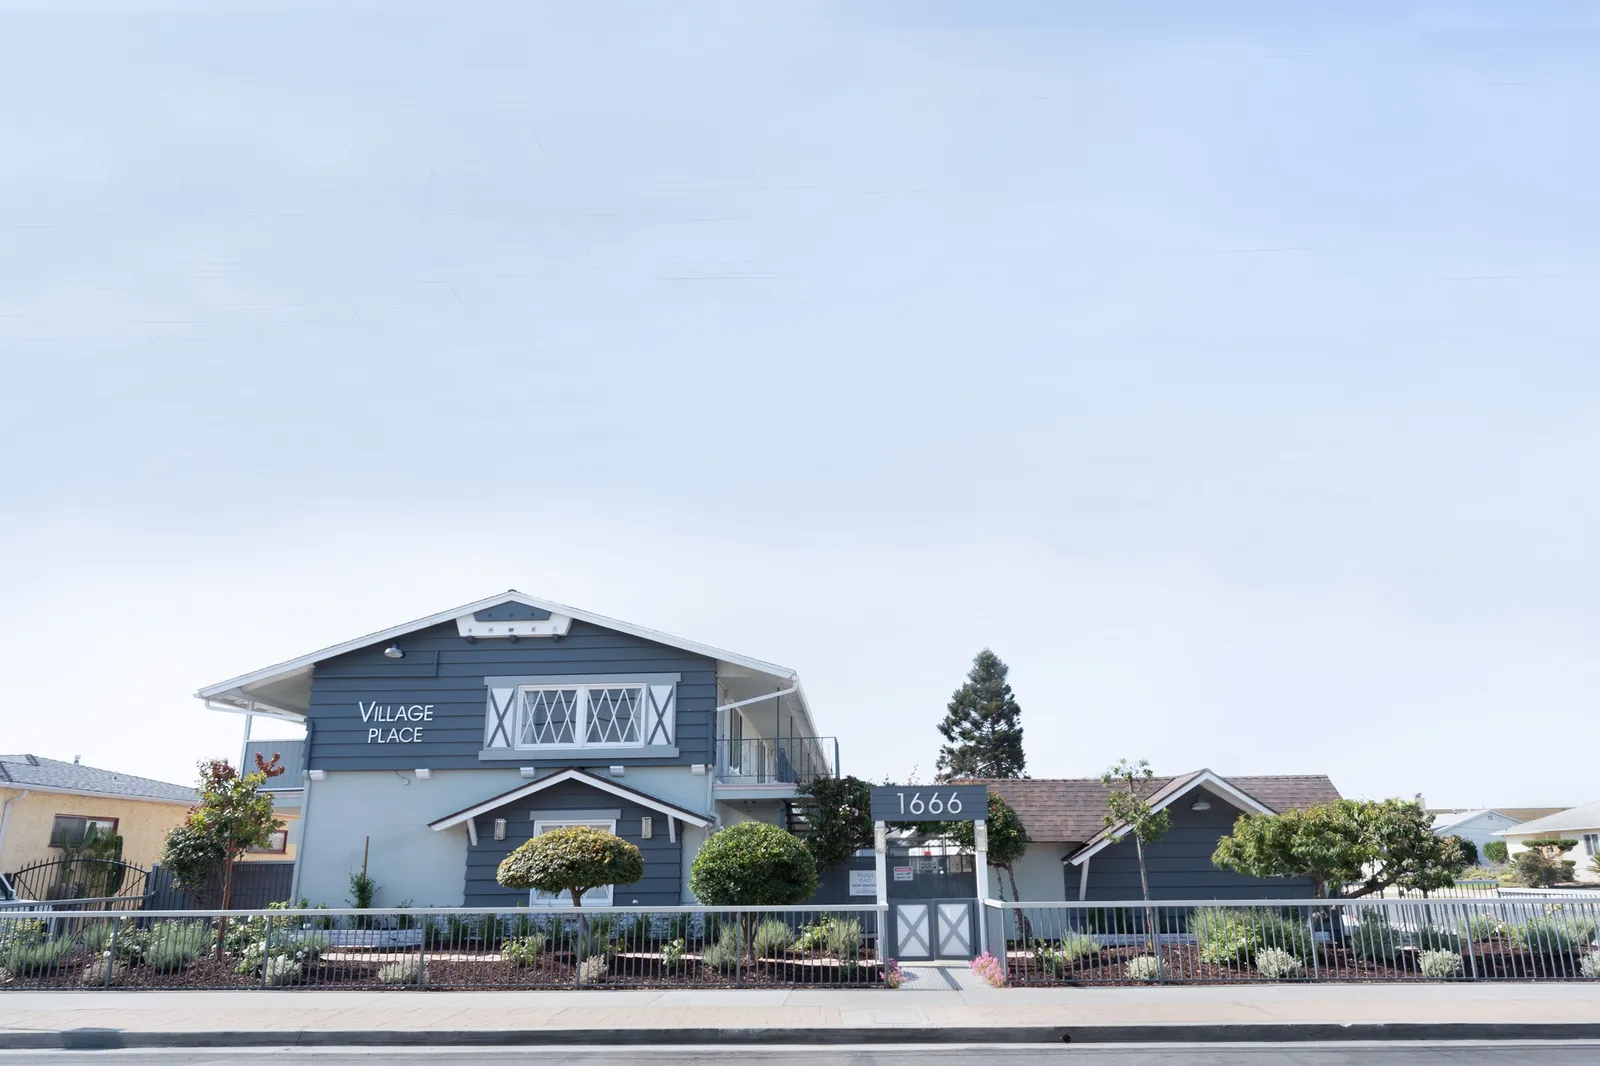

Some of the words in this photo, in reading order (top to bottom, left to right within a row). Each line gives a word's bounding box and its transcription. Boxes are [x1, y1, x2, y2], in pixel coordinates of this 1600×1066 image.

[358, 701, 434, 723] VILLAGE
[367, 727, 423, 743] PLACE
[897, 792, 962, 815] 1666
